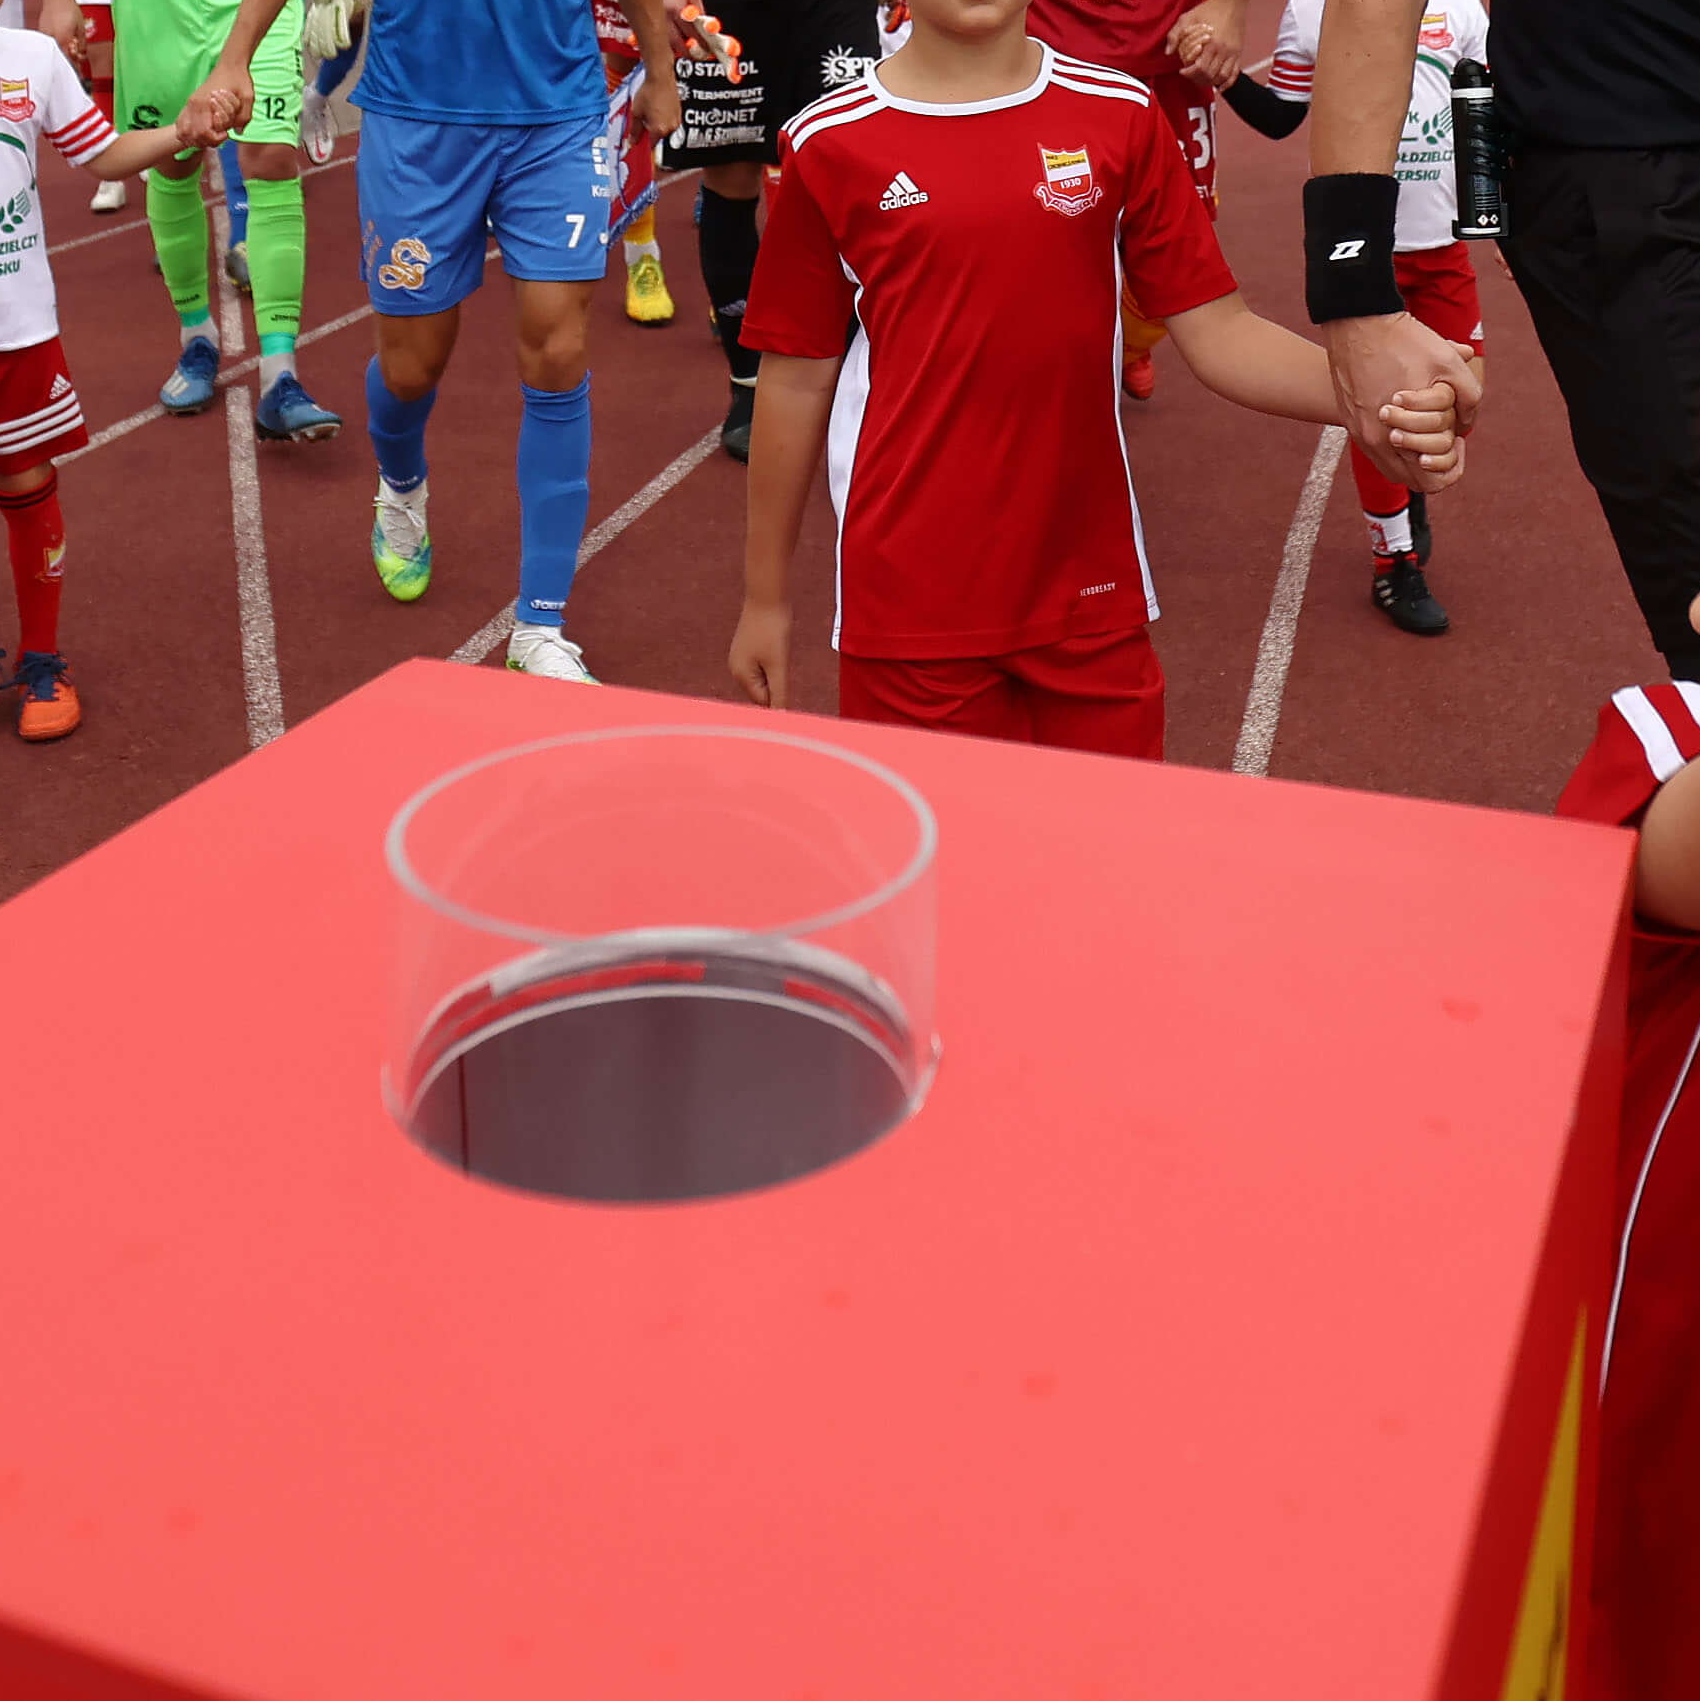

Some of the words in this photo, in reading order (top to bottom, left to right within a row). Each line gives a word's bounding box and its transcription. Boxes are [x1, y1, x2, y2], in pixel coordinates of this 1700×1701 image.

[263, 97, 287, 120] 12
[685, 107, 757, 125] CHOJNET
[1059, 177, 1082, 189] 1930
[879, 190, 929, 211] adidas
[565, 214, 586, 248] 7
